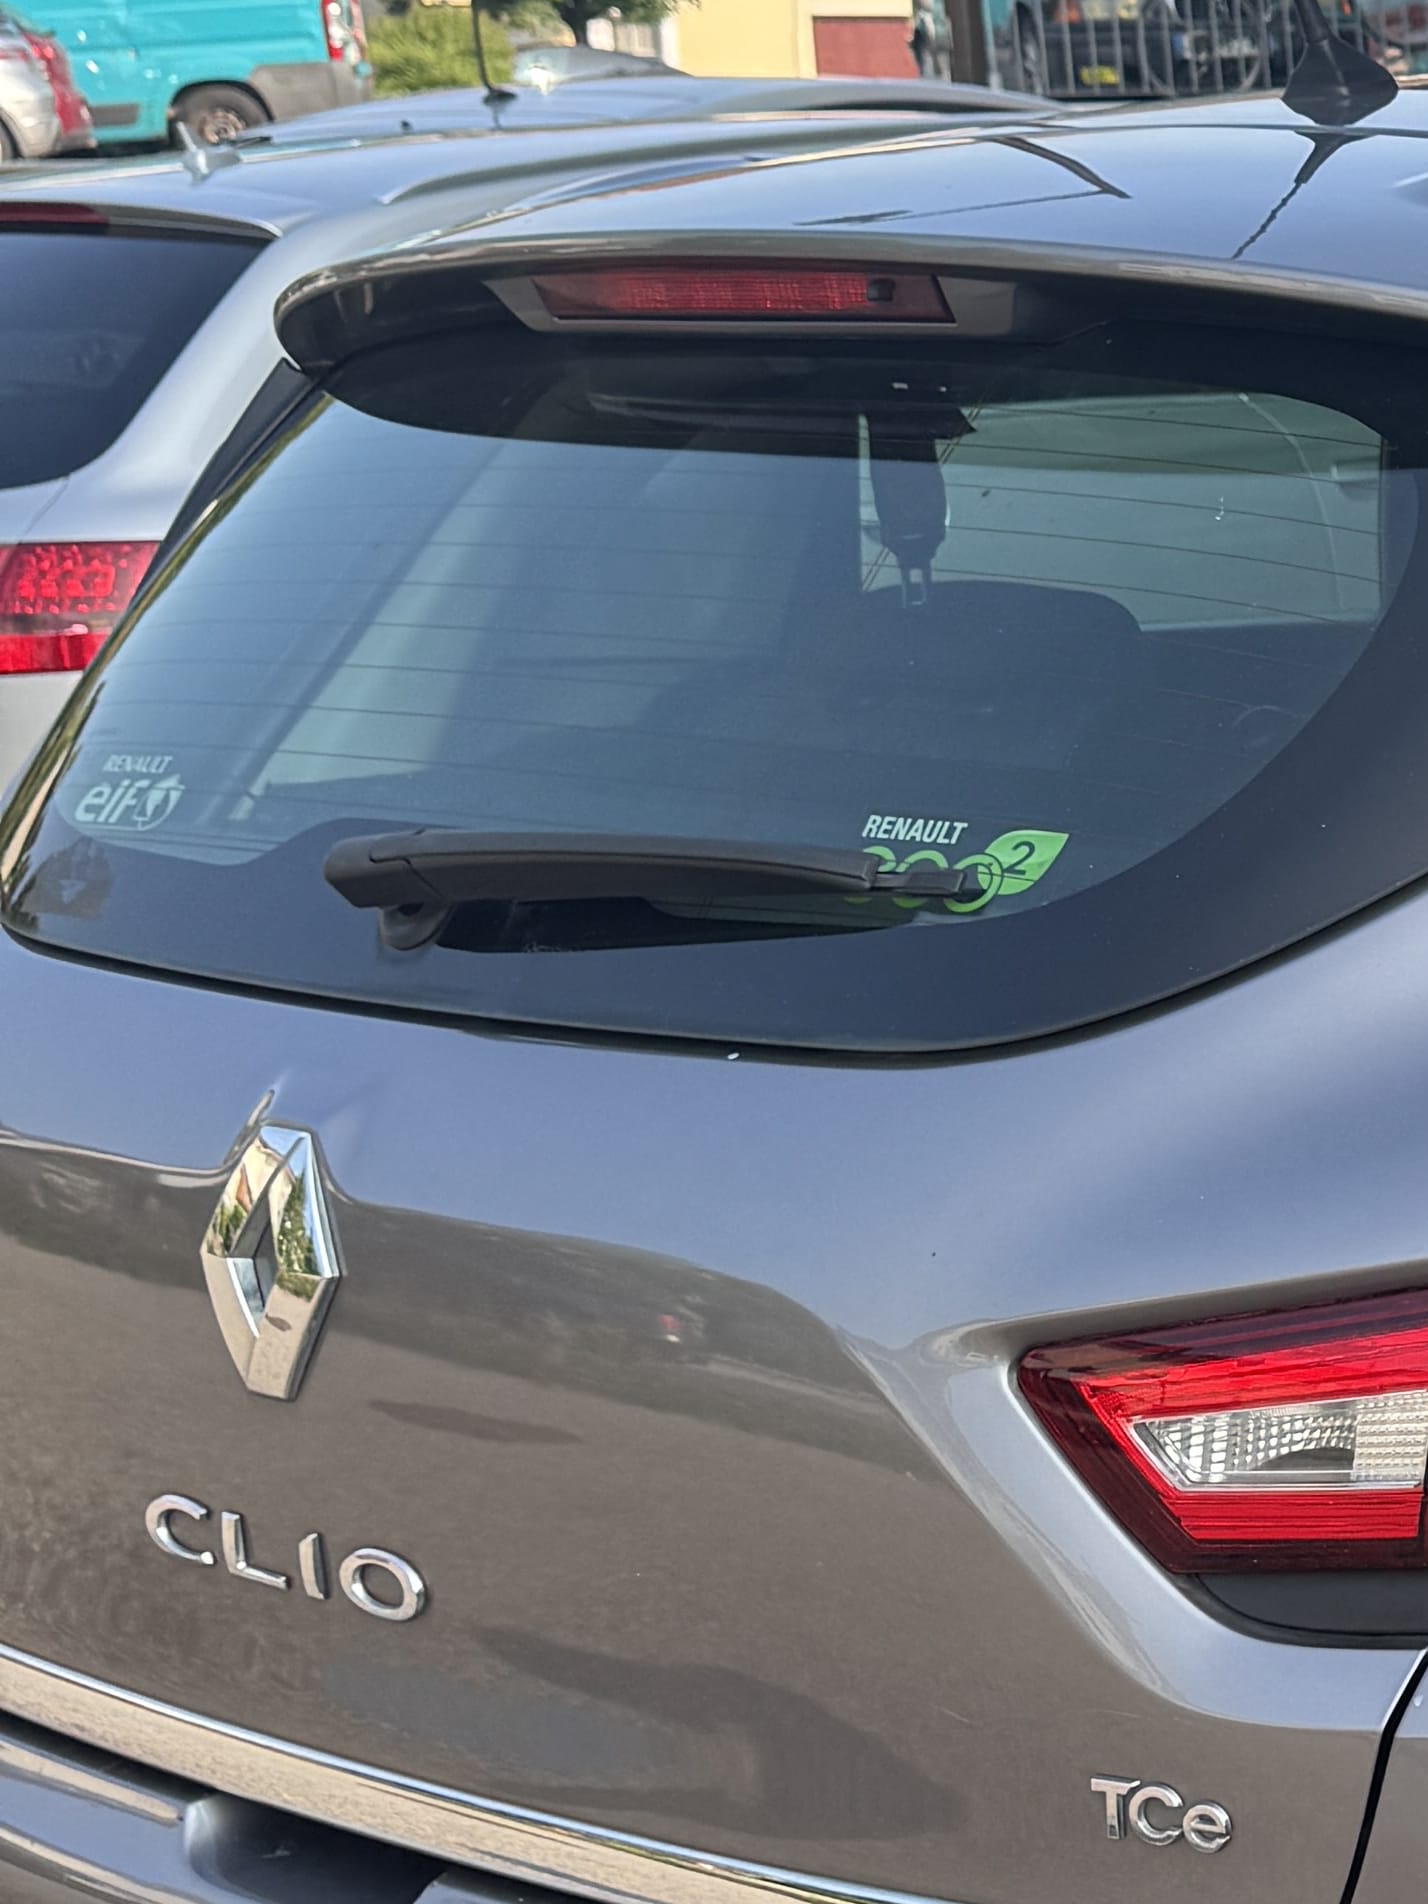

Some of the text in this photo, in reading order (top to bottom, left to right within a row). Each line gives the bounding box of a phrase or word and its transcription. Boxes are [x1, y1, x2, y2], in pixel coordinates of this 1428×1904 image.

[103, 754, 173, 774] RENAULT
[75, 778, 151, 824] elf
[861, 814, 969, 845] RENAULT
[144, 1492, 430, 1623] CLIO
[1090, 1773, 1233, 1854] TCe
